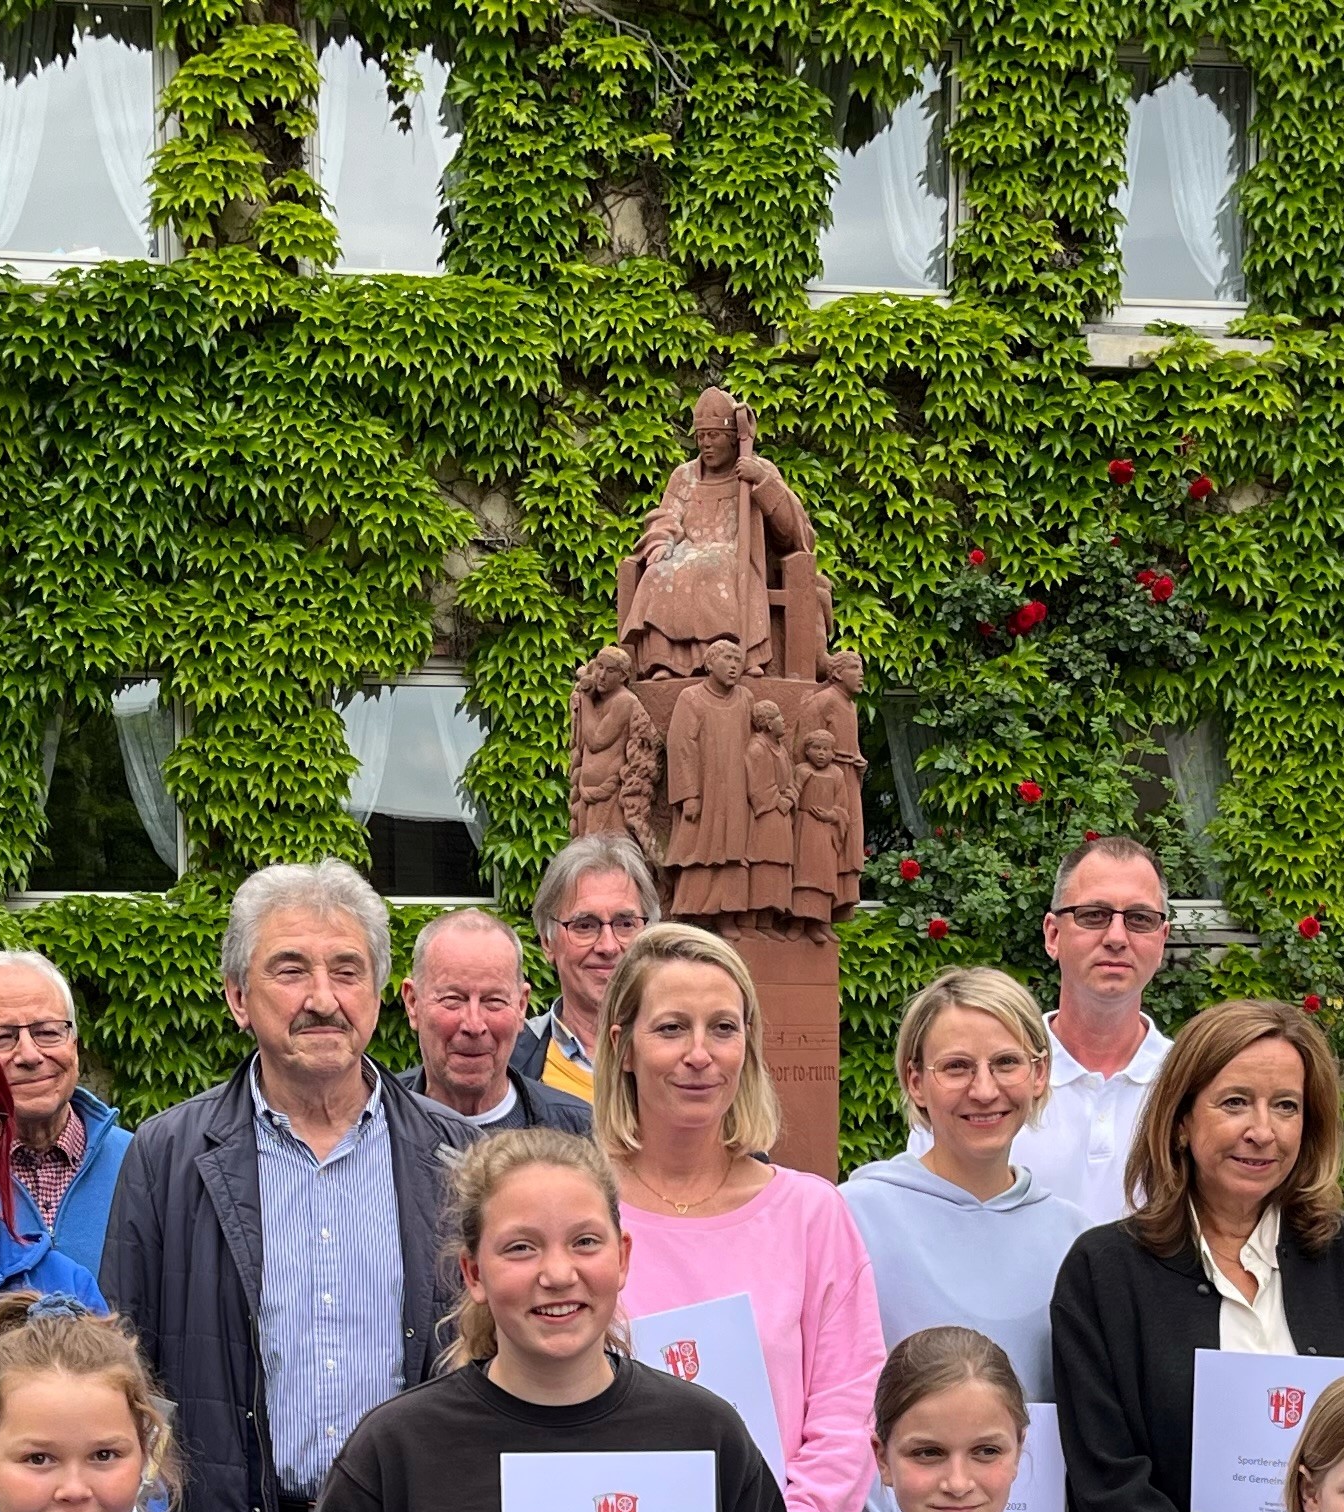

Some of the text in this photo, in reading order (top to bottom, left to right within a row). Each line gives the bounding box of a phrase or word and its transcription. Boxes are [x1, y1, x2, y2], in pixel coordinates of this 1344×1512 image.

[1232, 1473, 1284, 1485] der Gemein
[1006, 1502, 1027, 1511] 2023
